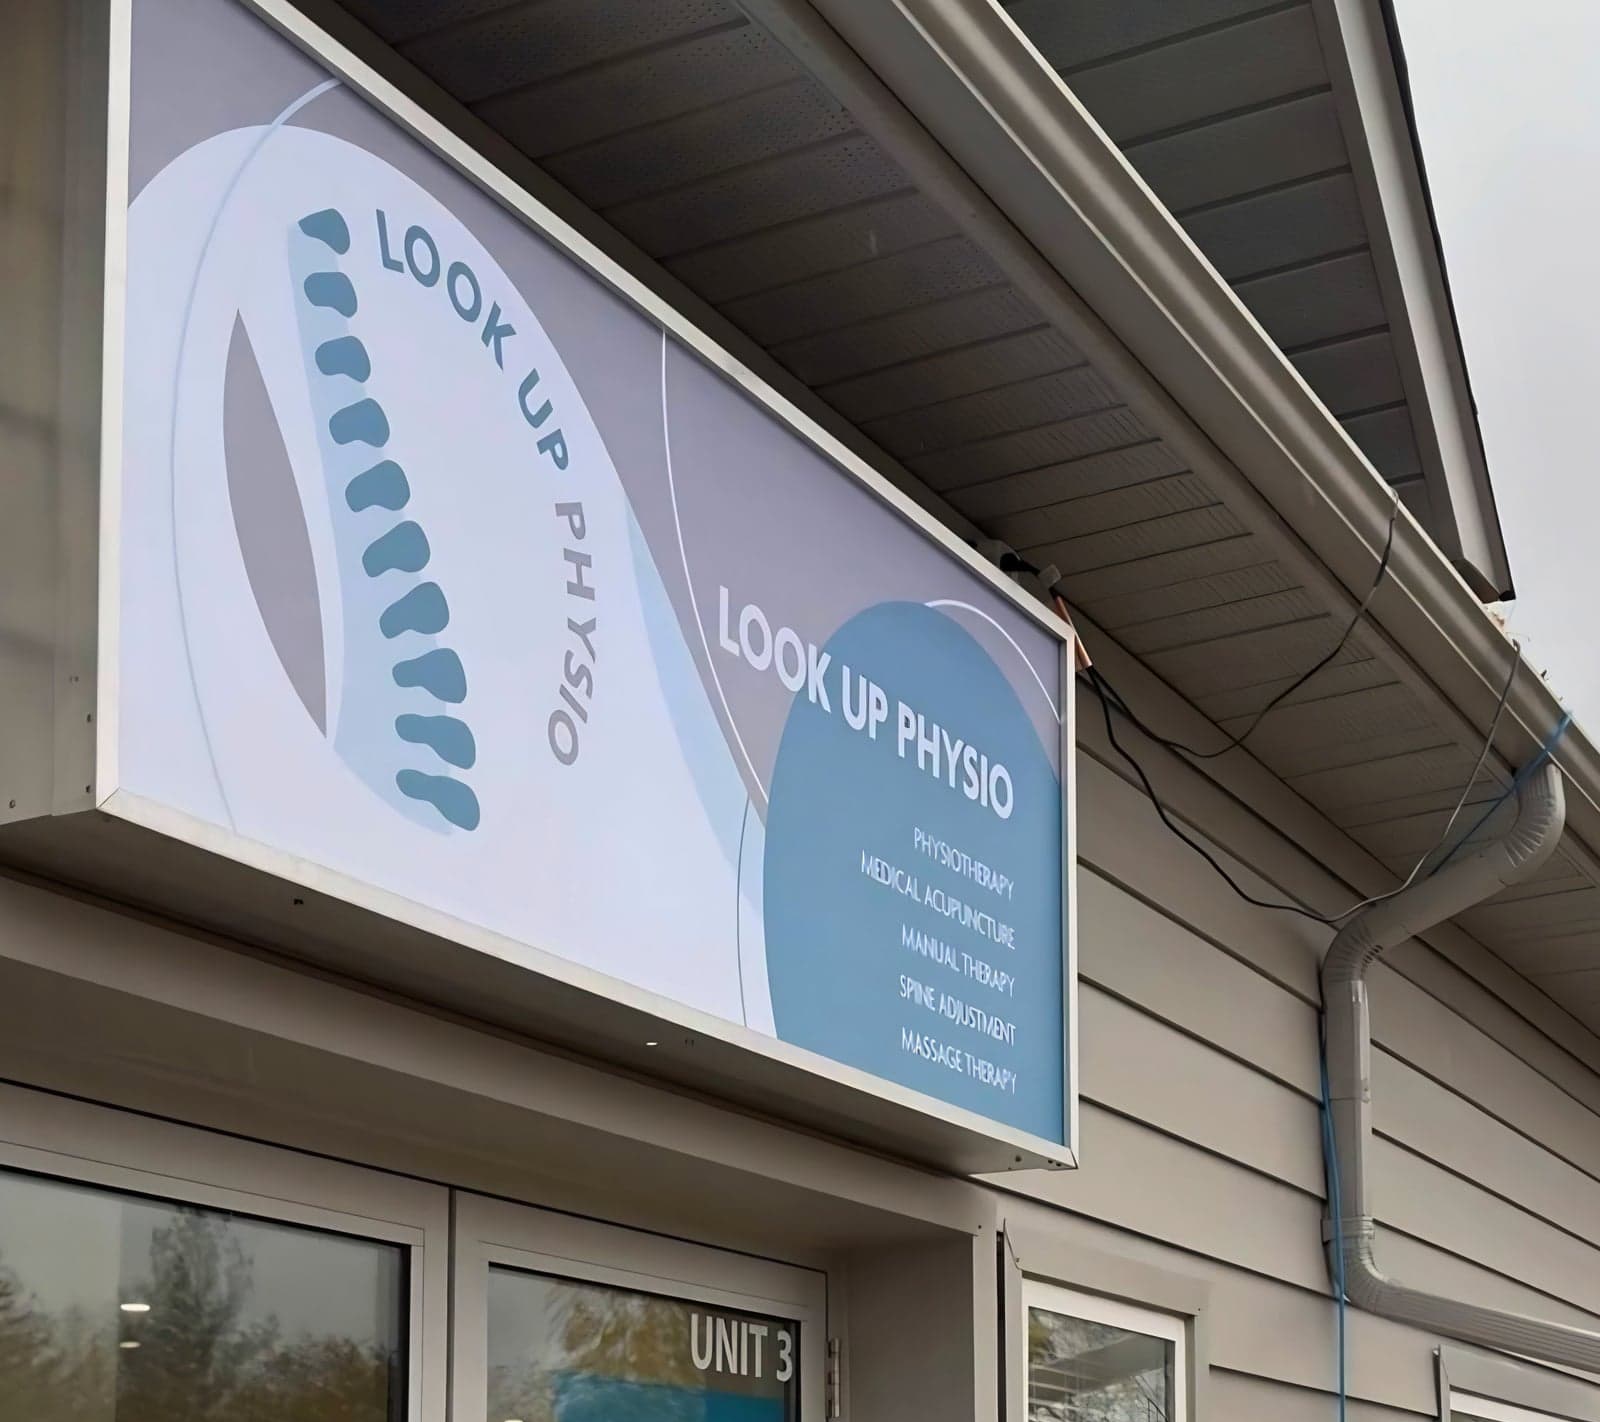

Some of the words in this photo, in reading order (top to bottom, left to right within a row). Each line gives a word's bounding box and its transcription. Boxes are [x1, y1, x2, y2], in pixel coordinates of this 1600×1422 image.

[376, 208, 516, 371] LOOK
[518, 368, 568, 471] UP
[547, 502, 597, 766] PHYSIO
[719, 585, 831, 714] LOOK
[842, 665, 888, 740] UP
[898, 700, 1014, 819] PHYSIO
[861, 849, 921, 902] MEDICAL
[924, 885, 1015, 950] ACUPUNCTURE
[914, 827, 1014, 900] PHYSIOTHERAPY
[902, 923, 960, 973] MANUAL
[961, 952, 1015, 997] THERAPY
[900, 975, 935, 1012] SPINE
[939, 993, 1016, 1047] ADJUSTMENT
[902, 1026, 963, 1073] MASSAGE
[964, 1052, 1016, 1095] THERAPY
[691, 1313, 768, 1378] UNIT
[776, 1329, 794, 1383] 3
